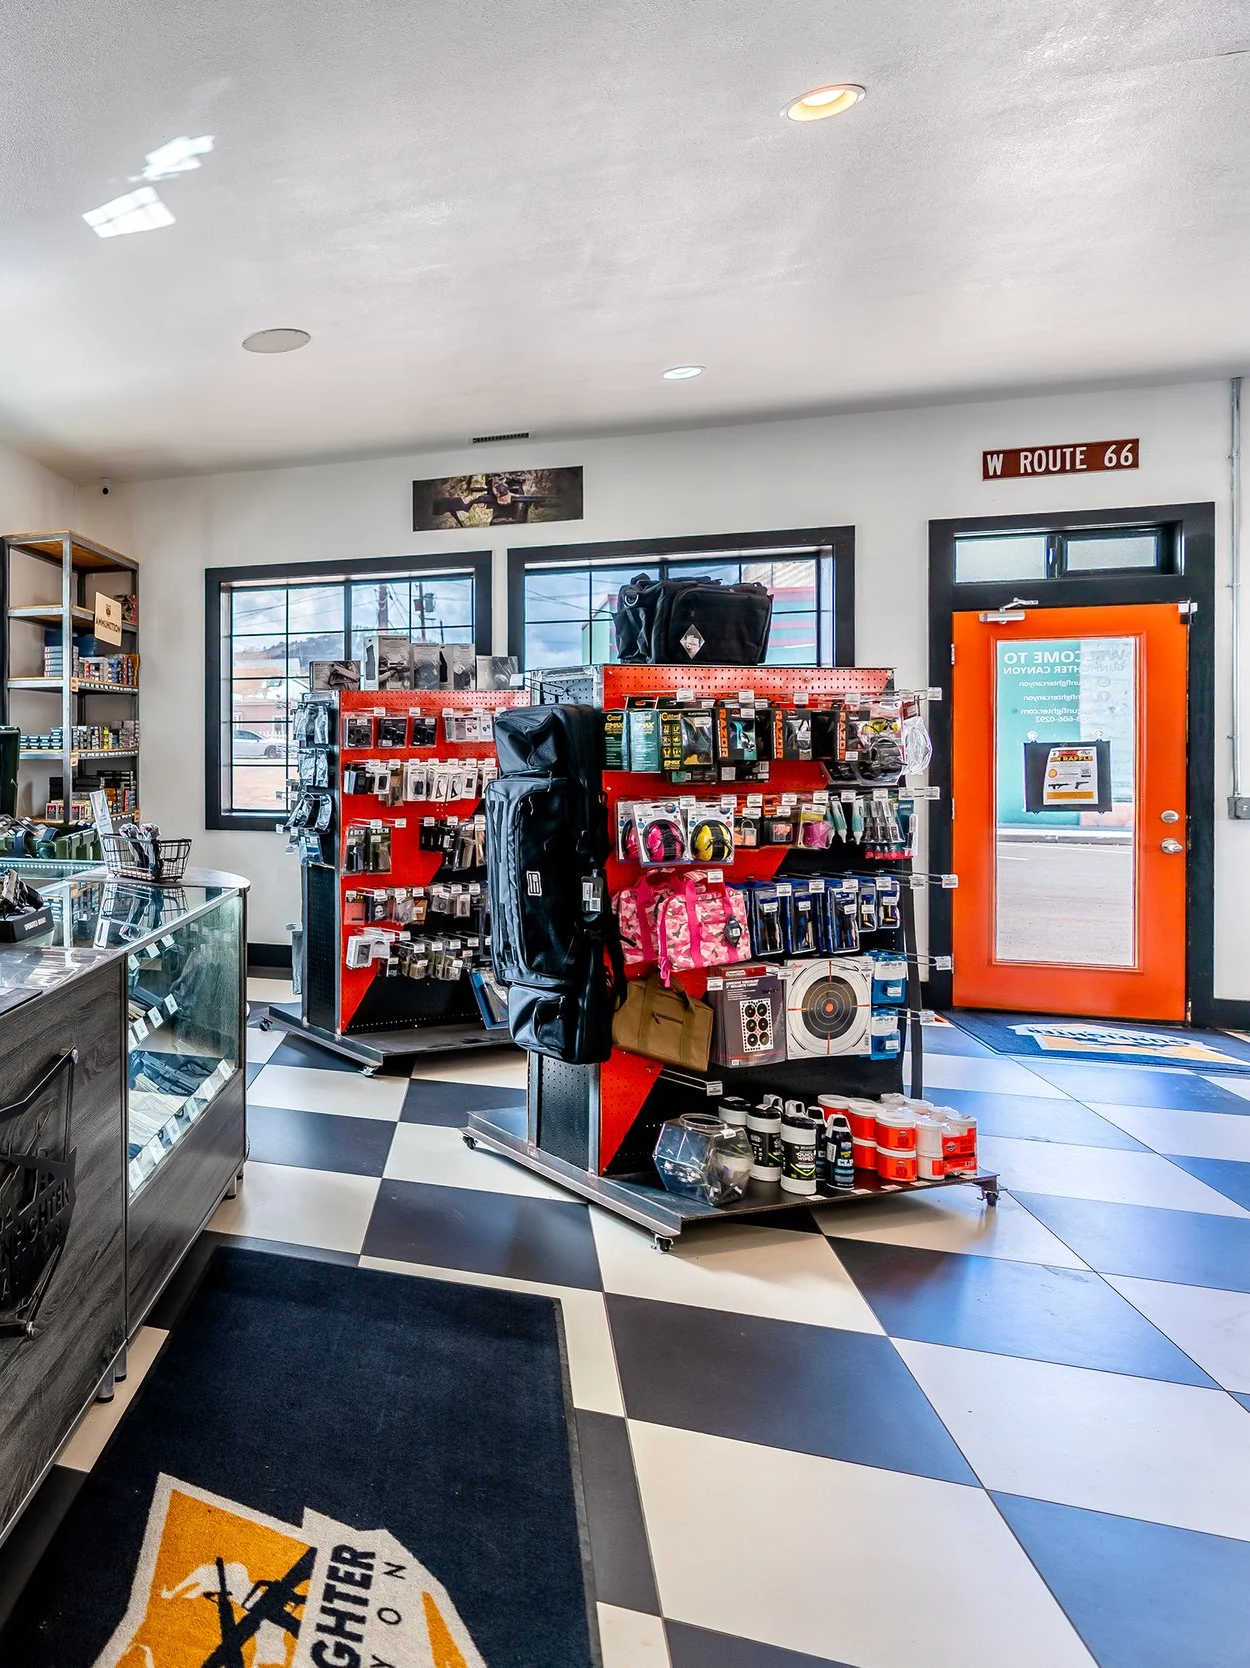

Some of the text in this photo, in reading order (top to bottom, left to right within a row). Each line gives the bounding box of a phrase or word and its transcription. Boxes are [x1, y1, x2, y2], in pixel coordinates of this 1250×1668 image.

[986, 442, 1134, 476] W ROUTE 66
[719, 708, 729, 758] RAZOR
[775, 710, 784, 759] RAZOR
[839, 711, 847, 760] RAZOR
